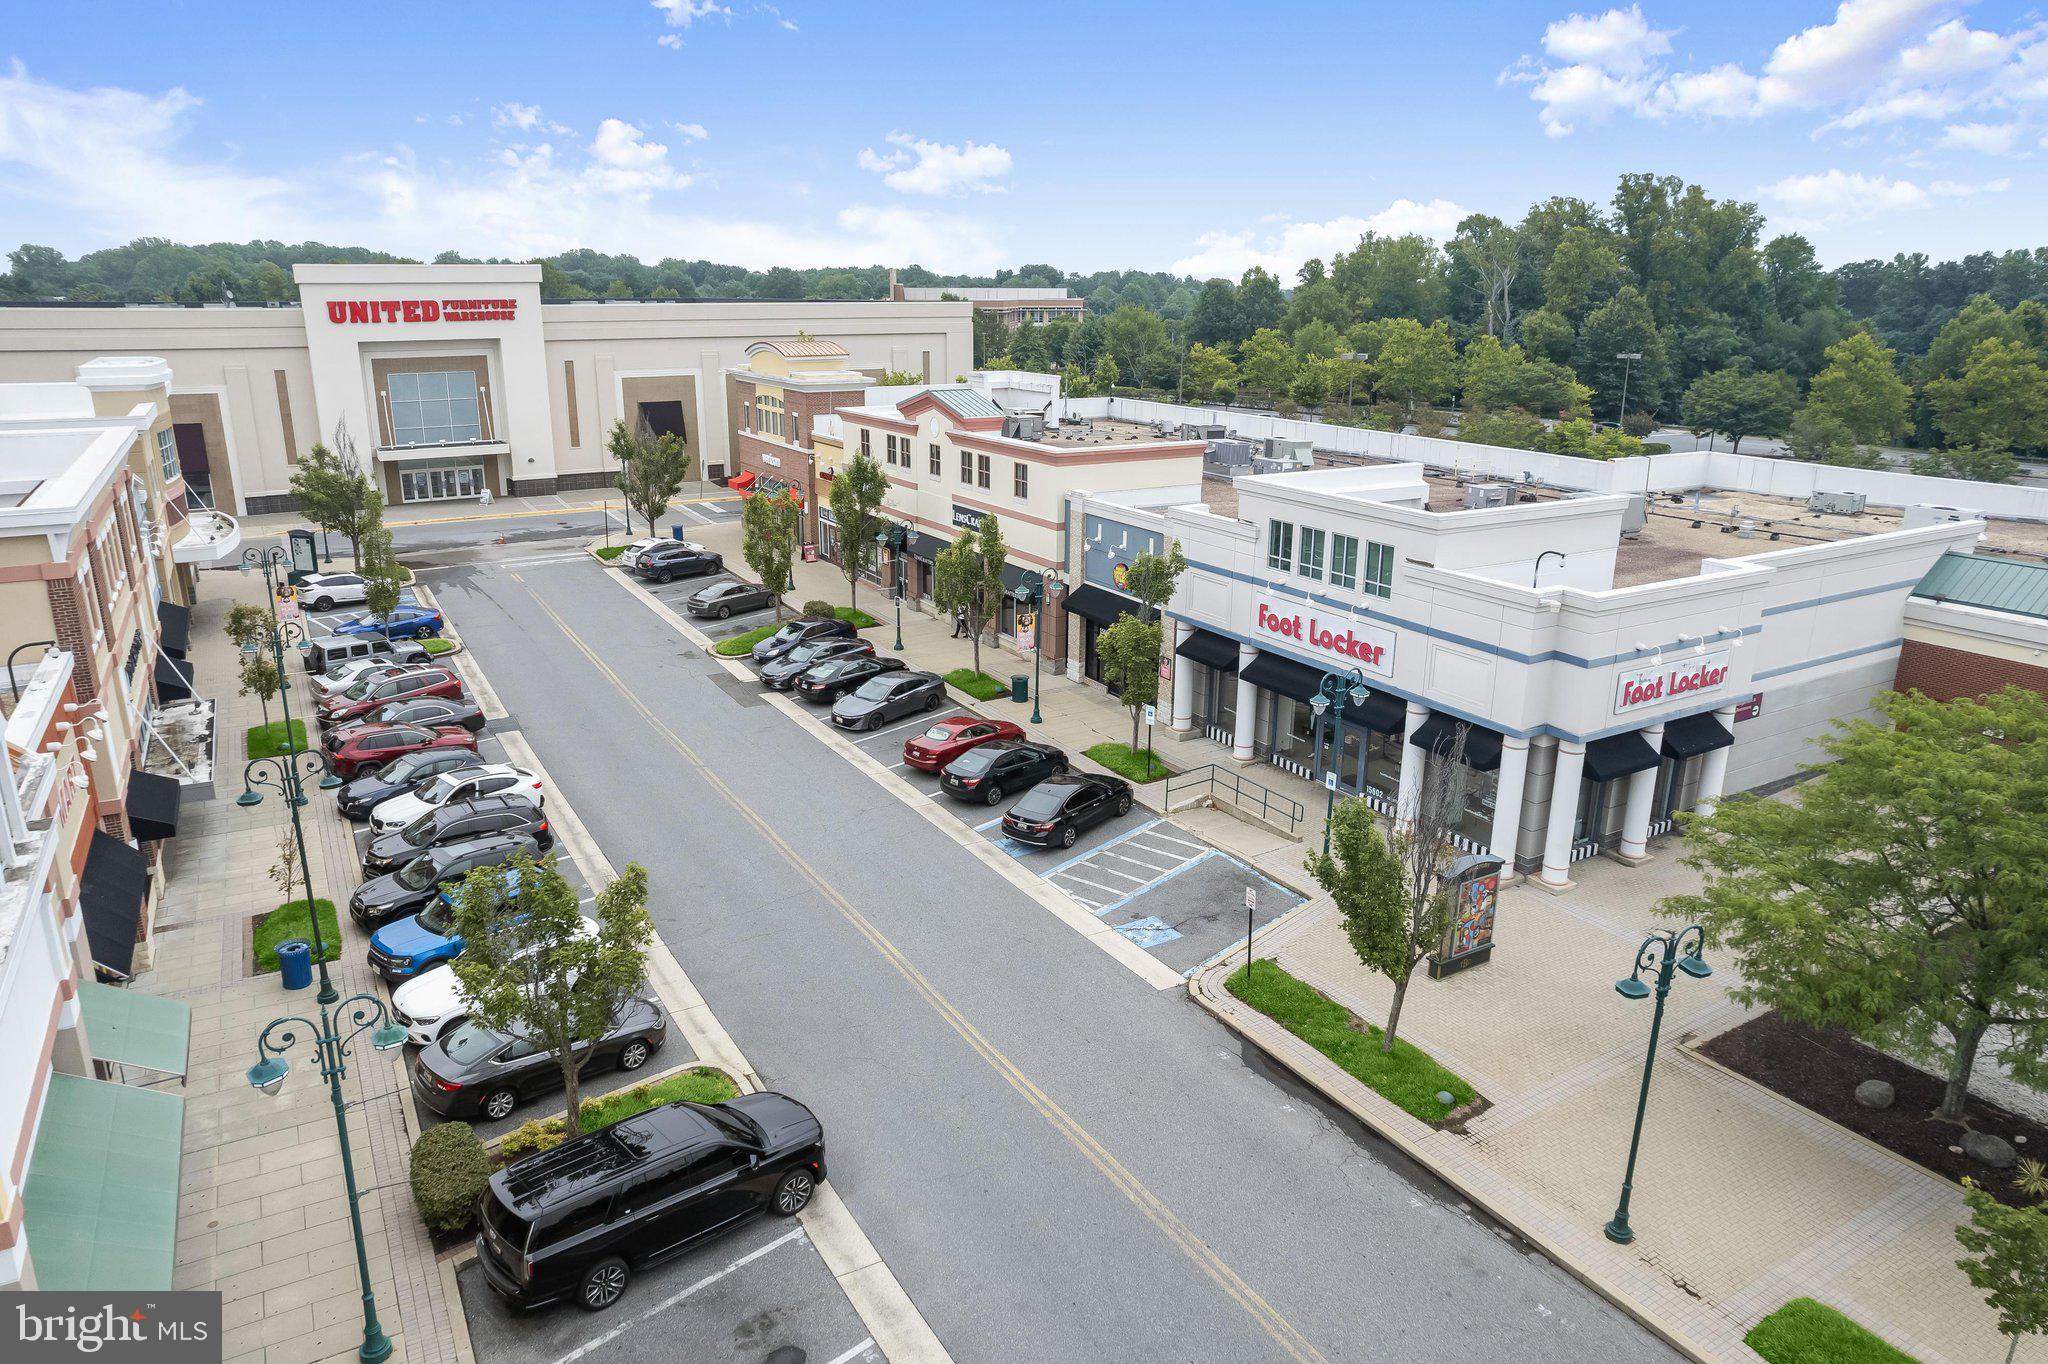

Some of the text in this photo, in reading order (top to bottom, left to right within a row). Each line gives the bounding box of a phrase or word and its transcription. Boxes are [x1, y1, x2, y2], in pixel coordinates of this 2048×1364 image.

[326, 300, 440, 324] UNITED
[442, 299, 518, 310] FURNITURE
[443, 311, 516, 322] WAREHOUSE
[1258, 603, 1385, 666] Foot Locker
[1622, 665, 1729, 707] Foot Locker
